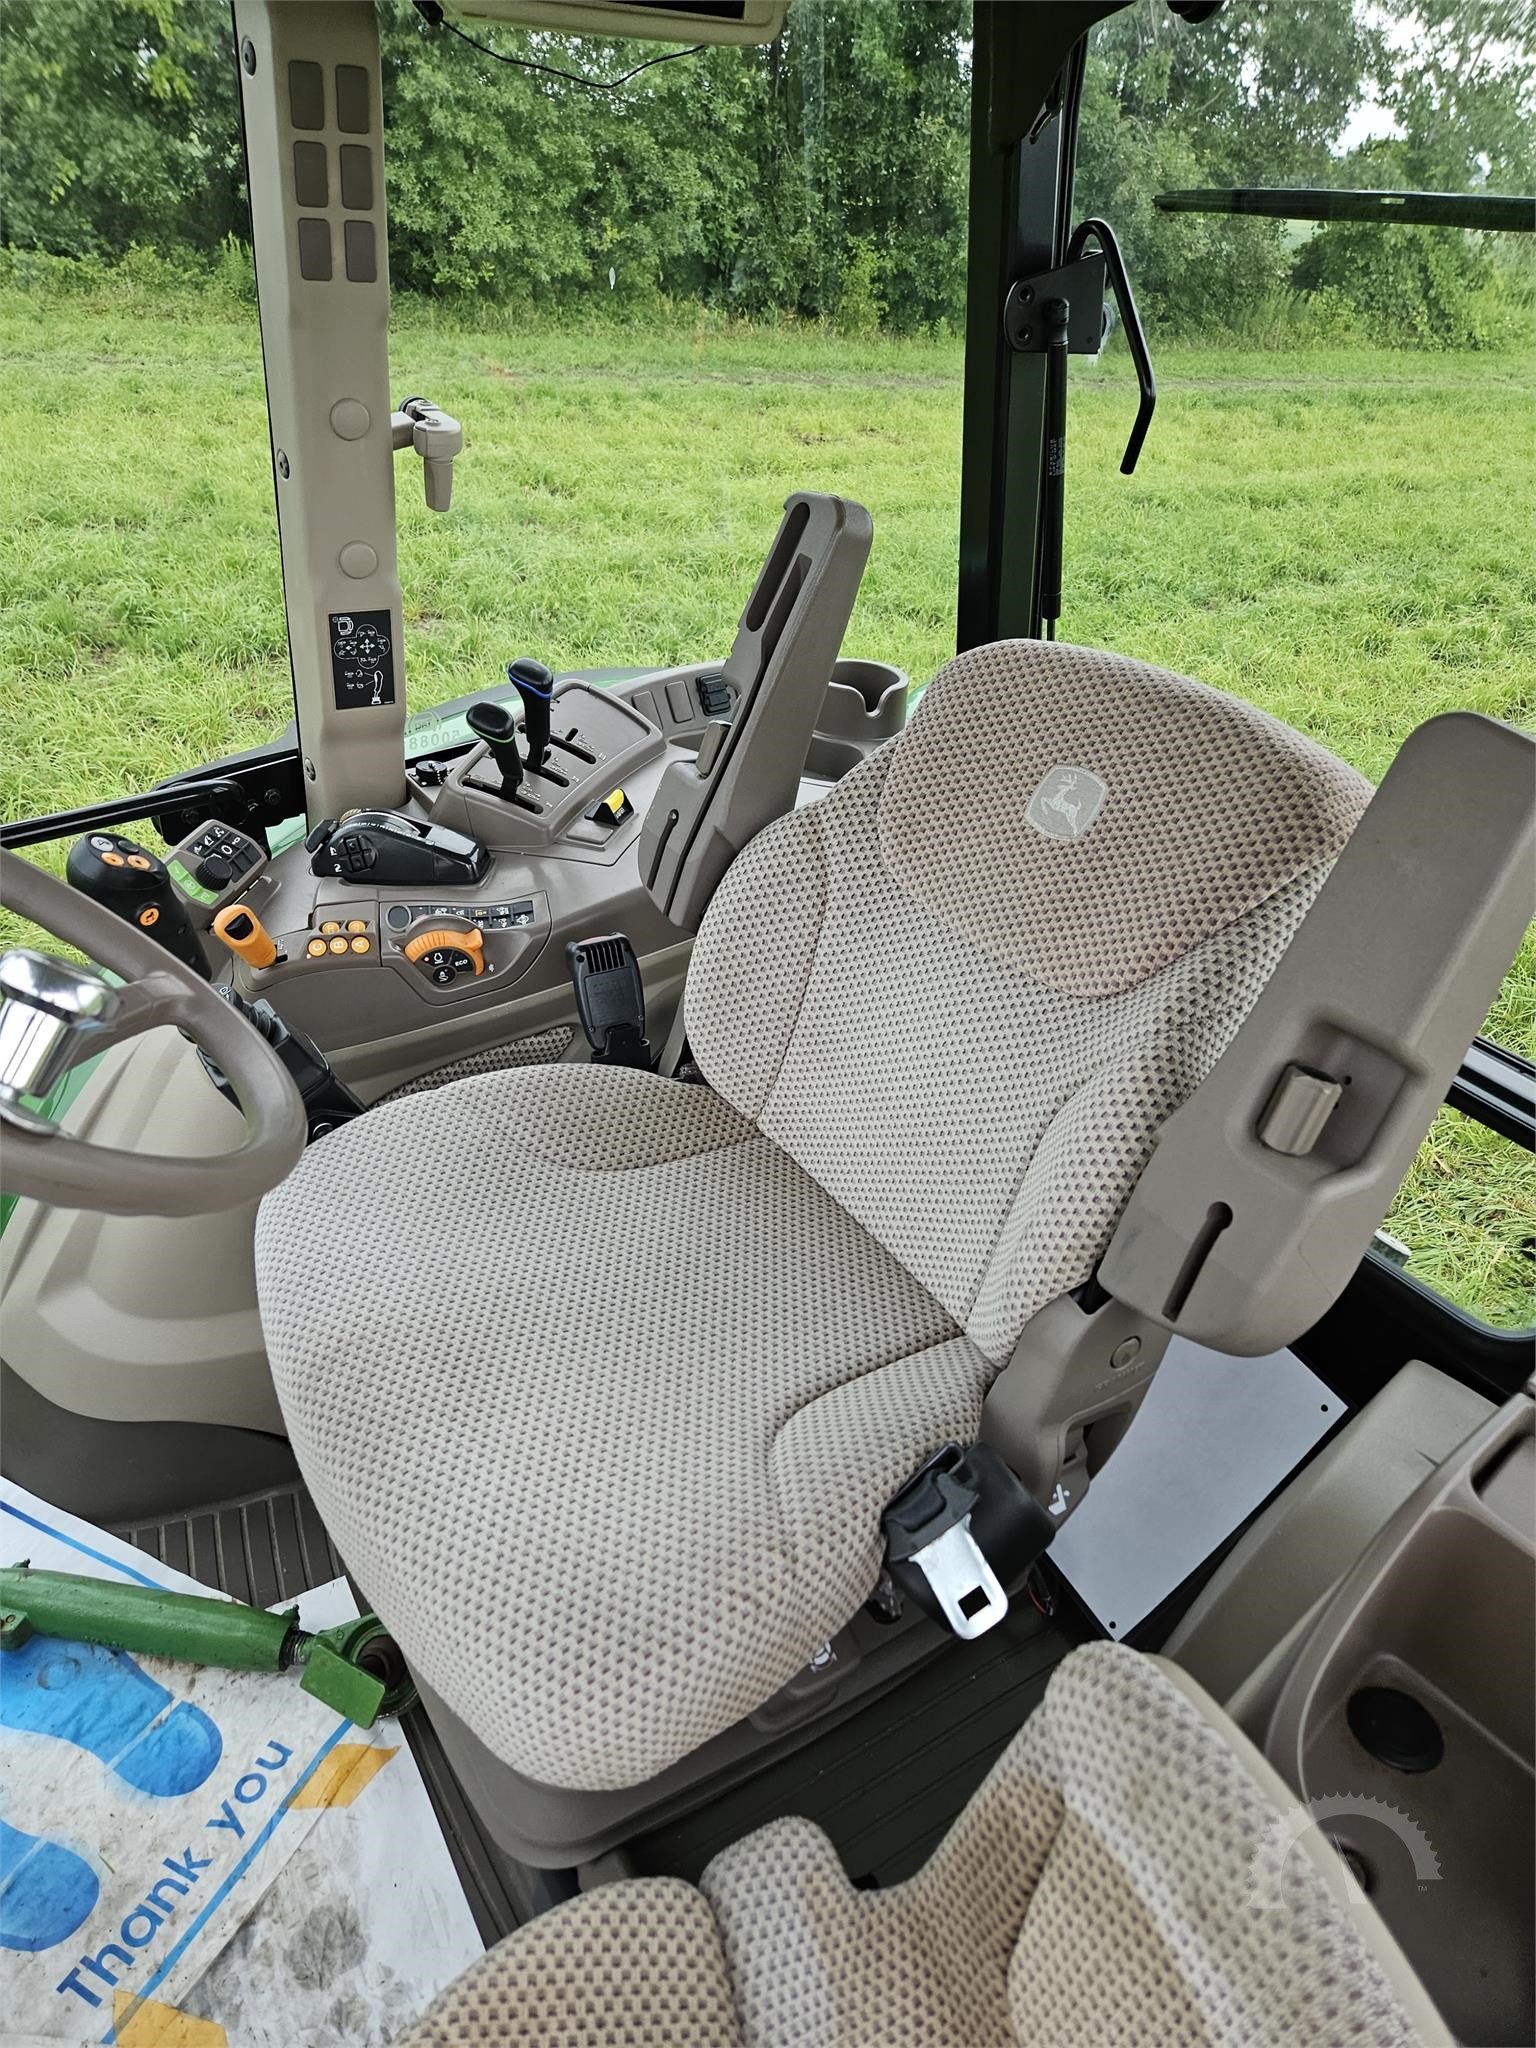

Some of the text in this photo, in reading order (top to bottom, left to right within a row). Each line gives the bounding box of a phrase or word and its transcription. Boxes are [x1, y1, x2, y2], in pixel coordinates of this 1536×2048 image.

[455, 958, 468, 967] ECO
[56, 1740, 294, 2008] Thank you
